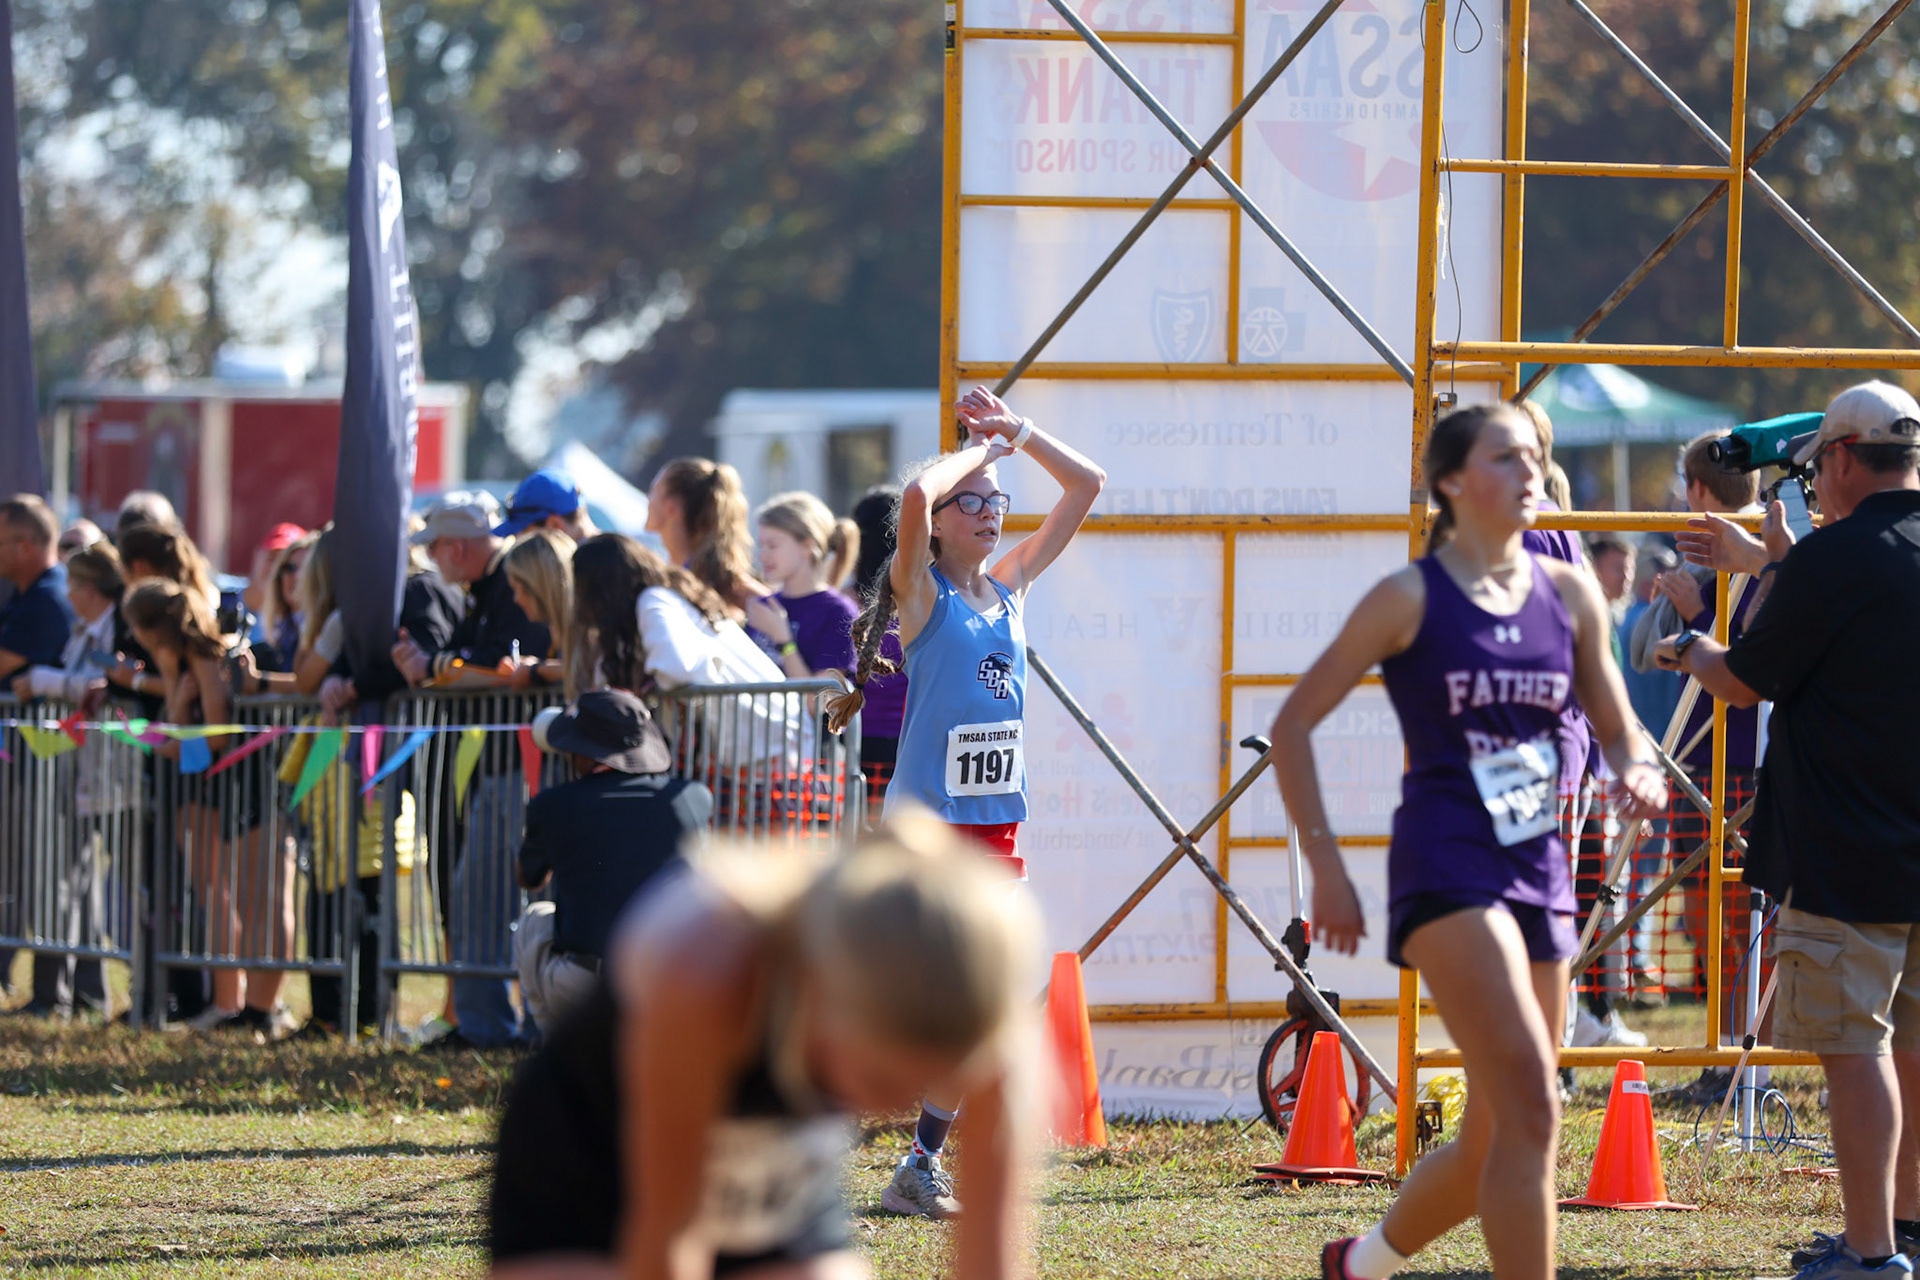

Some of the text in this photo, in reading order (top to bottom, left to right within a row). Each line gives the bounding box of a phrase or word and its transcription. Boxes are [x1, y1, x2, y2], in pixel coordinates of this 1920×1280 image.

[978, 660, 1010, 699] SBA
[958, 729, 1018, 743] TMSAA STATE XC
[956, 748, 1014, 785] 1197
